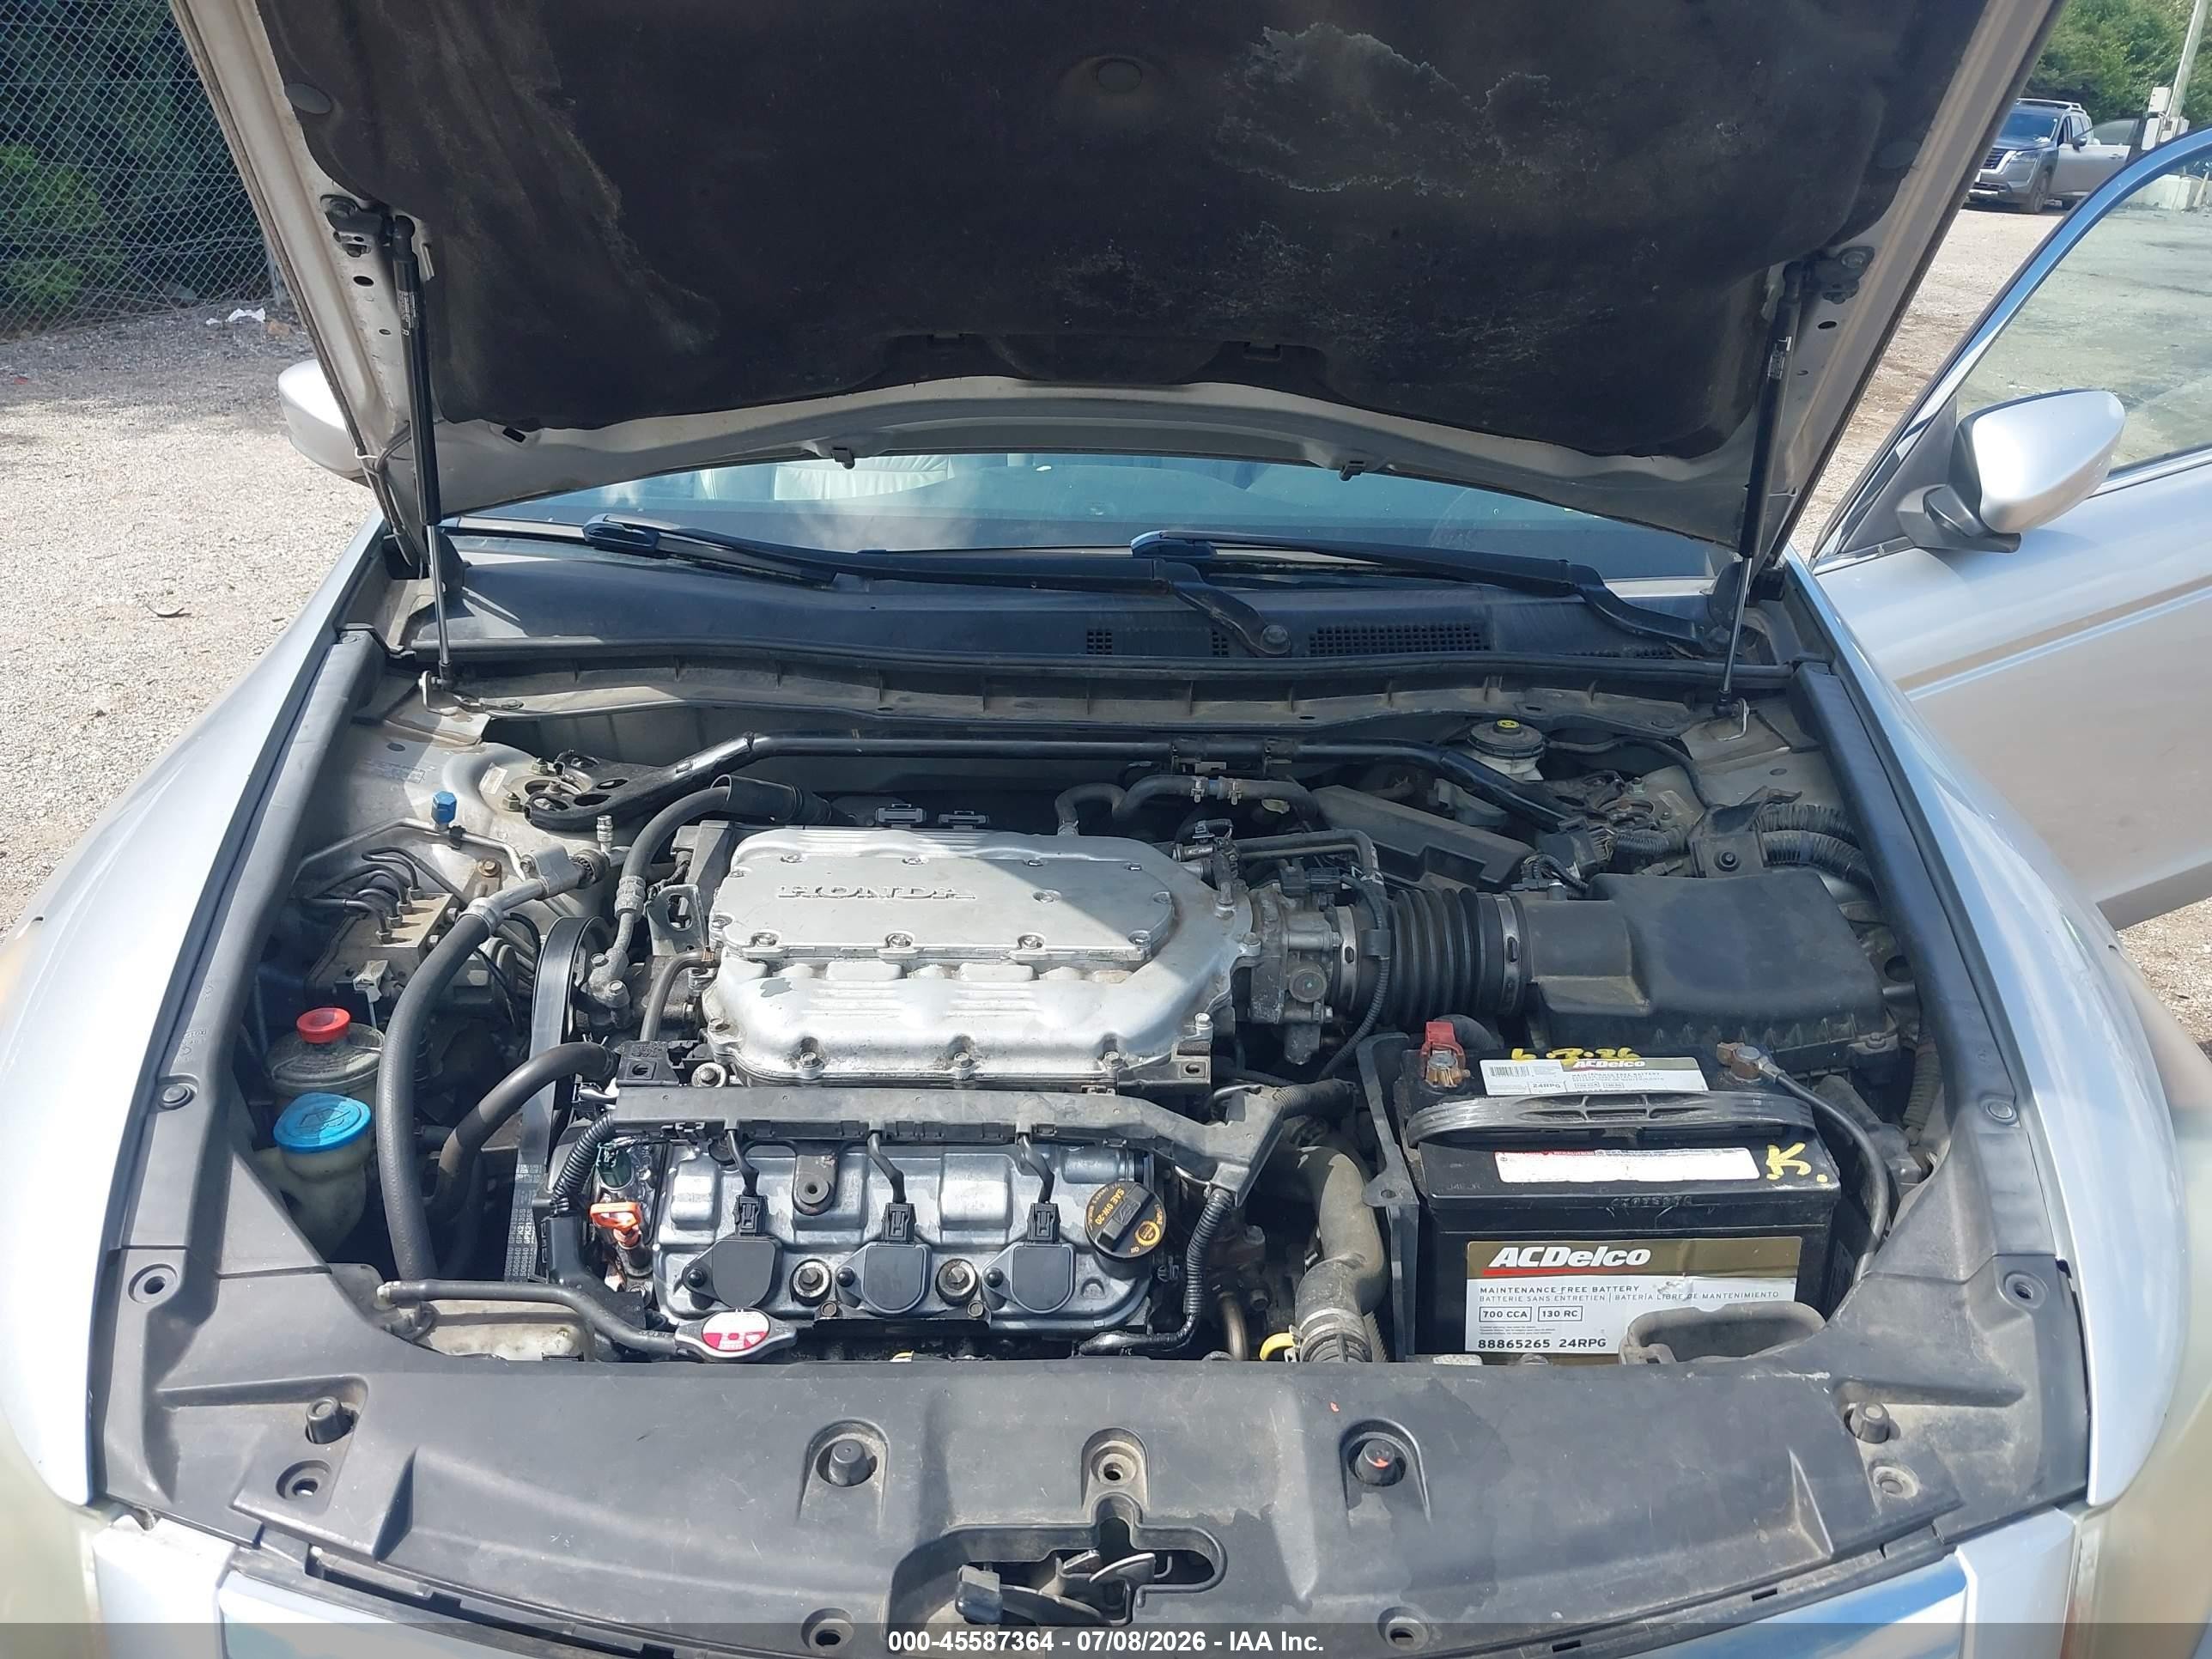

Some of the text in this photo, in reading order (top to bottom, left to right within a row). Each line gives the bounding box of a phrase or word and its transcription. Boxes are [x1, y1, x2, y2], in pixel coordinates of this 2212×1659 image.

[778, 884, 976, 899] HONDA
[1110, 1188, 1125, 1205] SAE
[1488, 1245, 1651, 1268] ACDelco
[1702, 1291, 1779, 1299] MANTENIMIENTO
[1478, 1338, 1607, 1349] 88865265 24RPG
